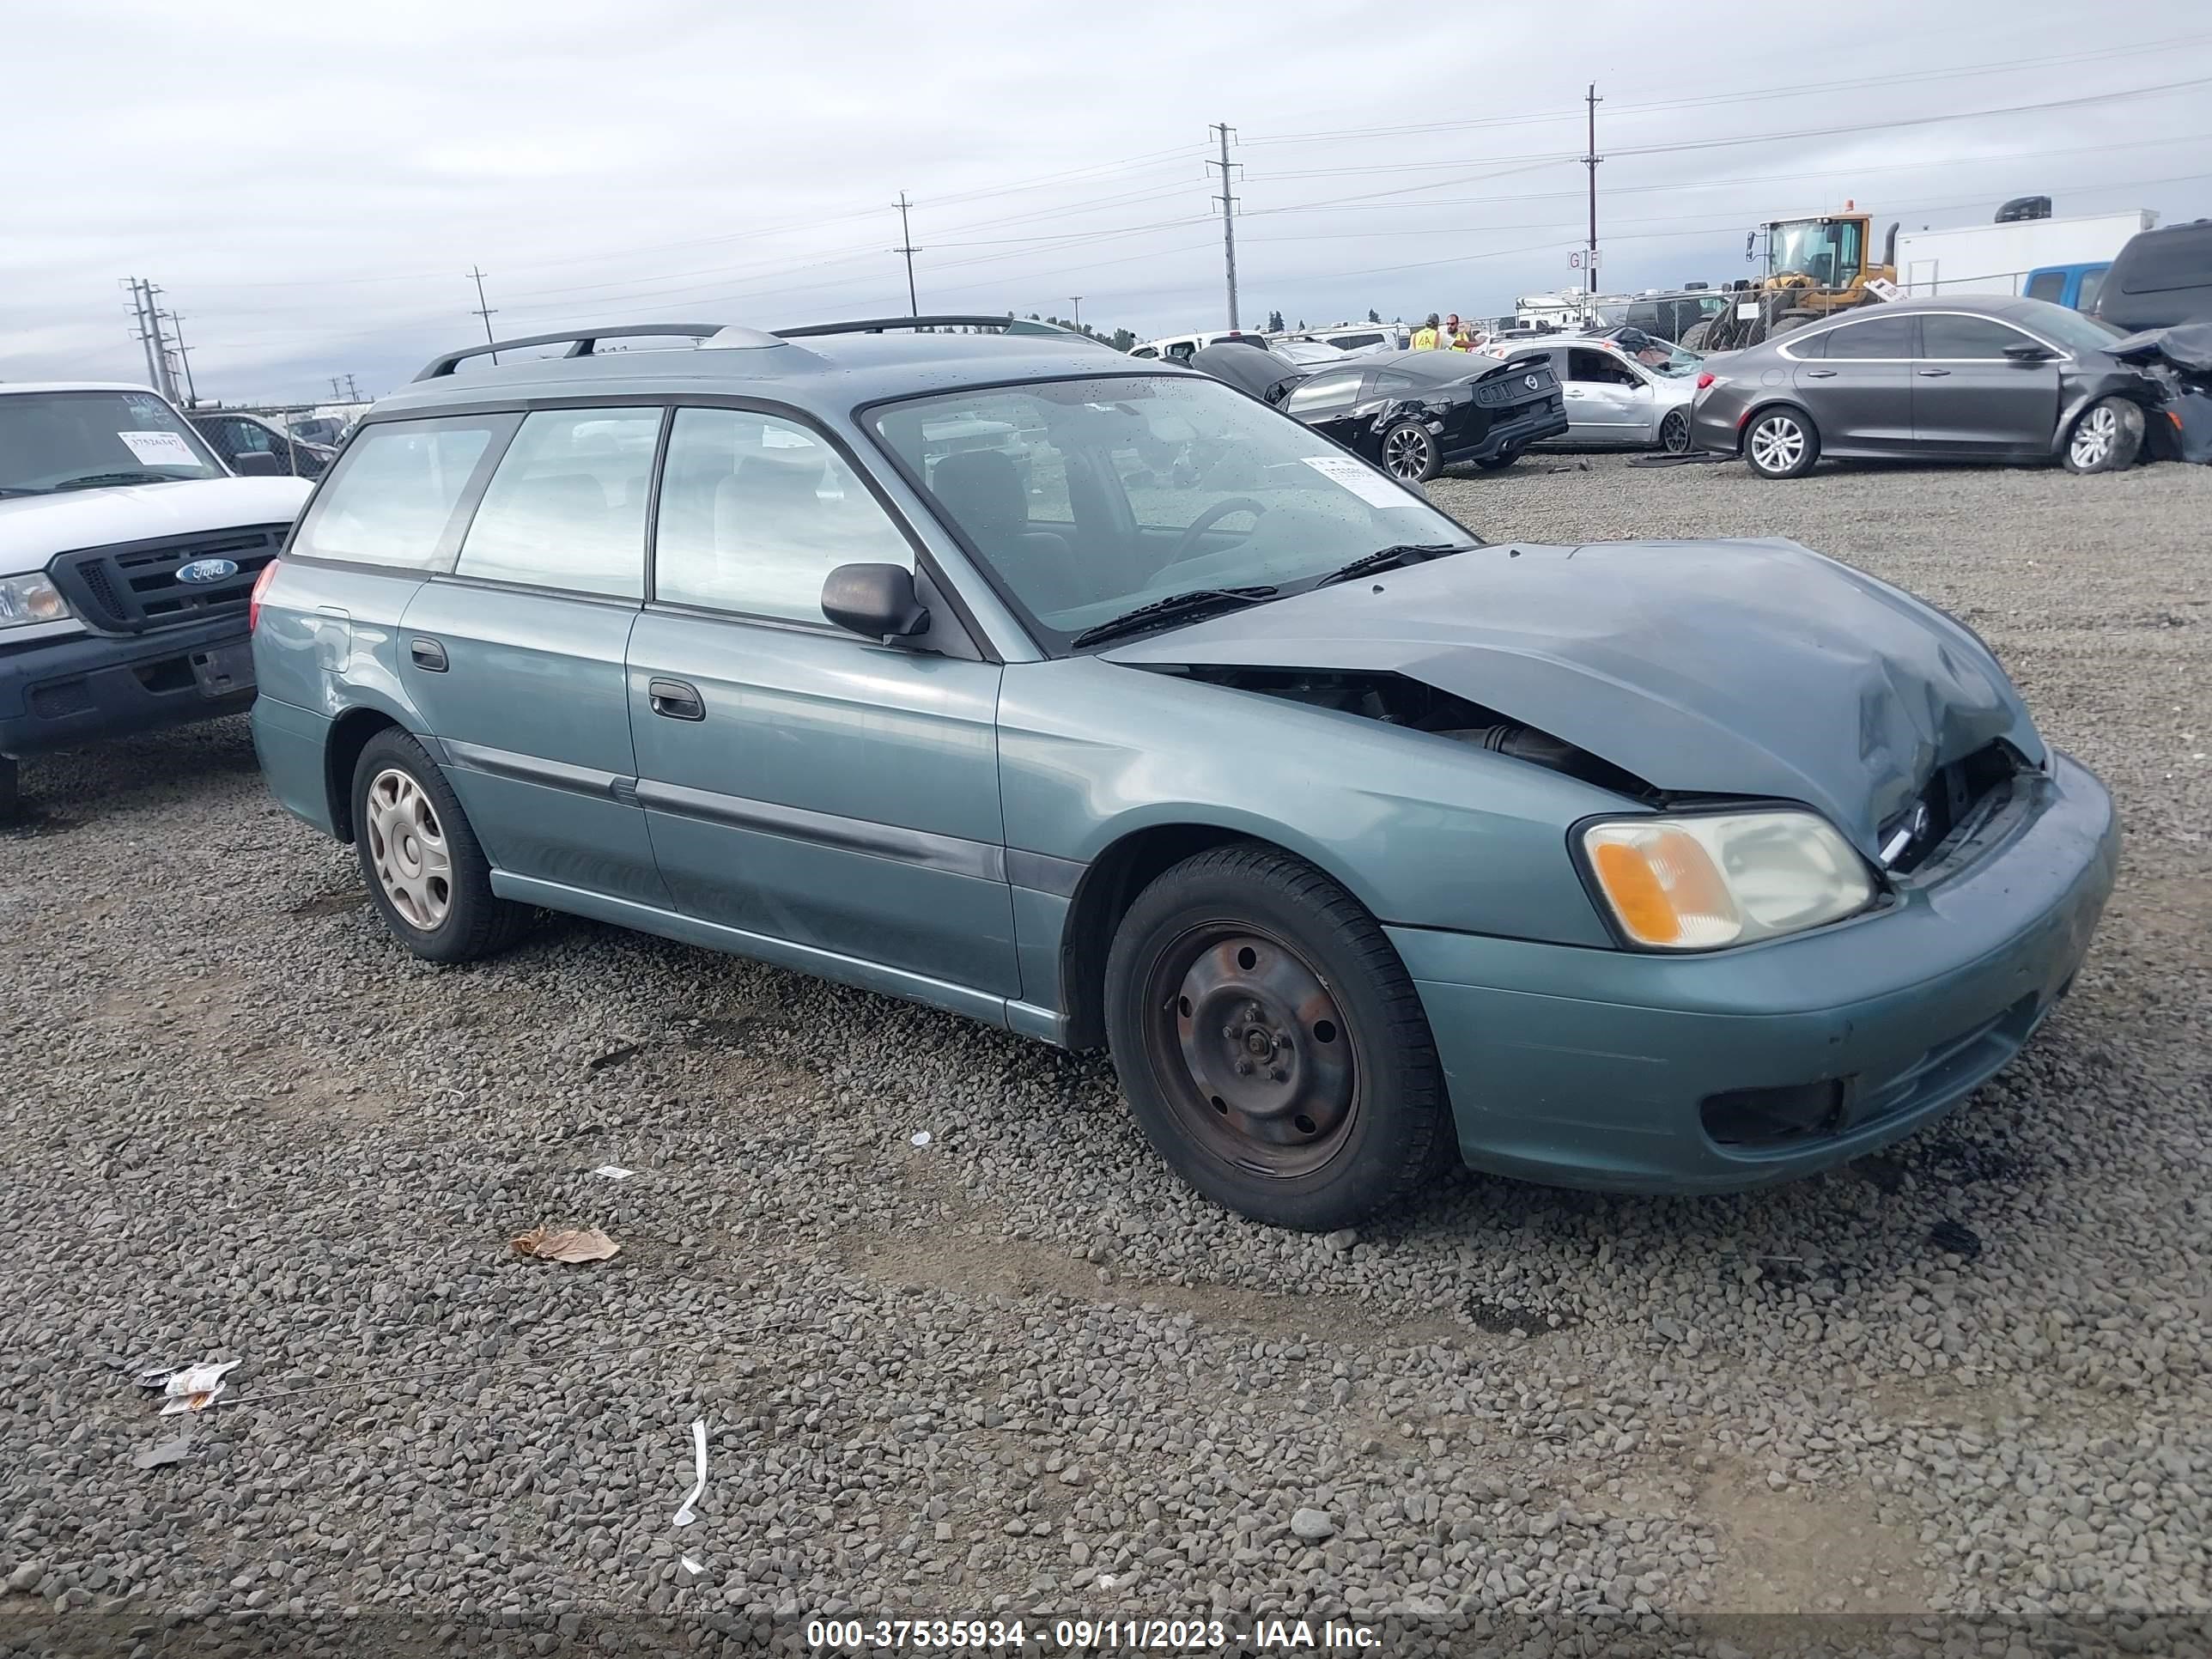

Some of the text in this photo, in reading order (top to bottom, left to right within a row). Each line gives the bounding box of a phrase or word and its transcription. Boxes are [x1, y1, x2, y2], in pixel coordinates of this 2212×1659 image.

[1570, 252, 1580, 268] G
[1590, 252, 1599, 268] F
[192, 562, 225, 581] Ford
